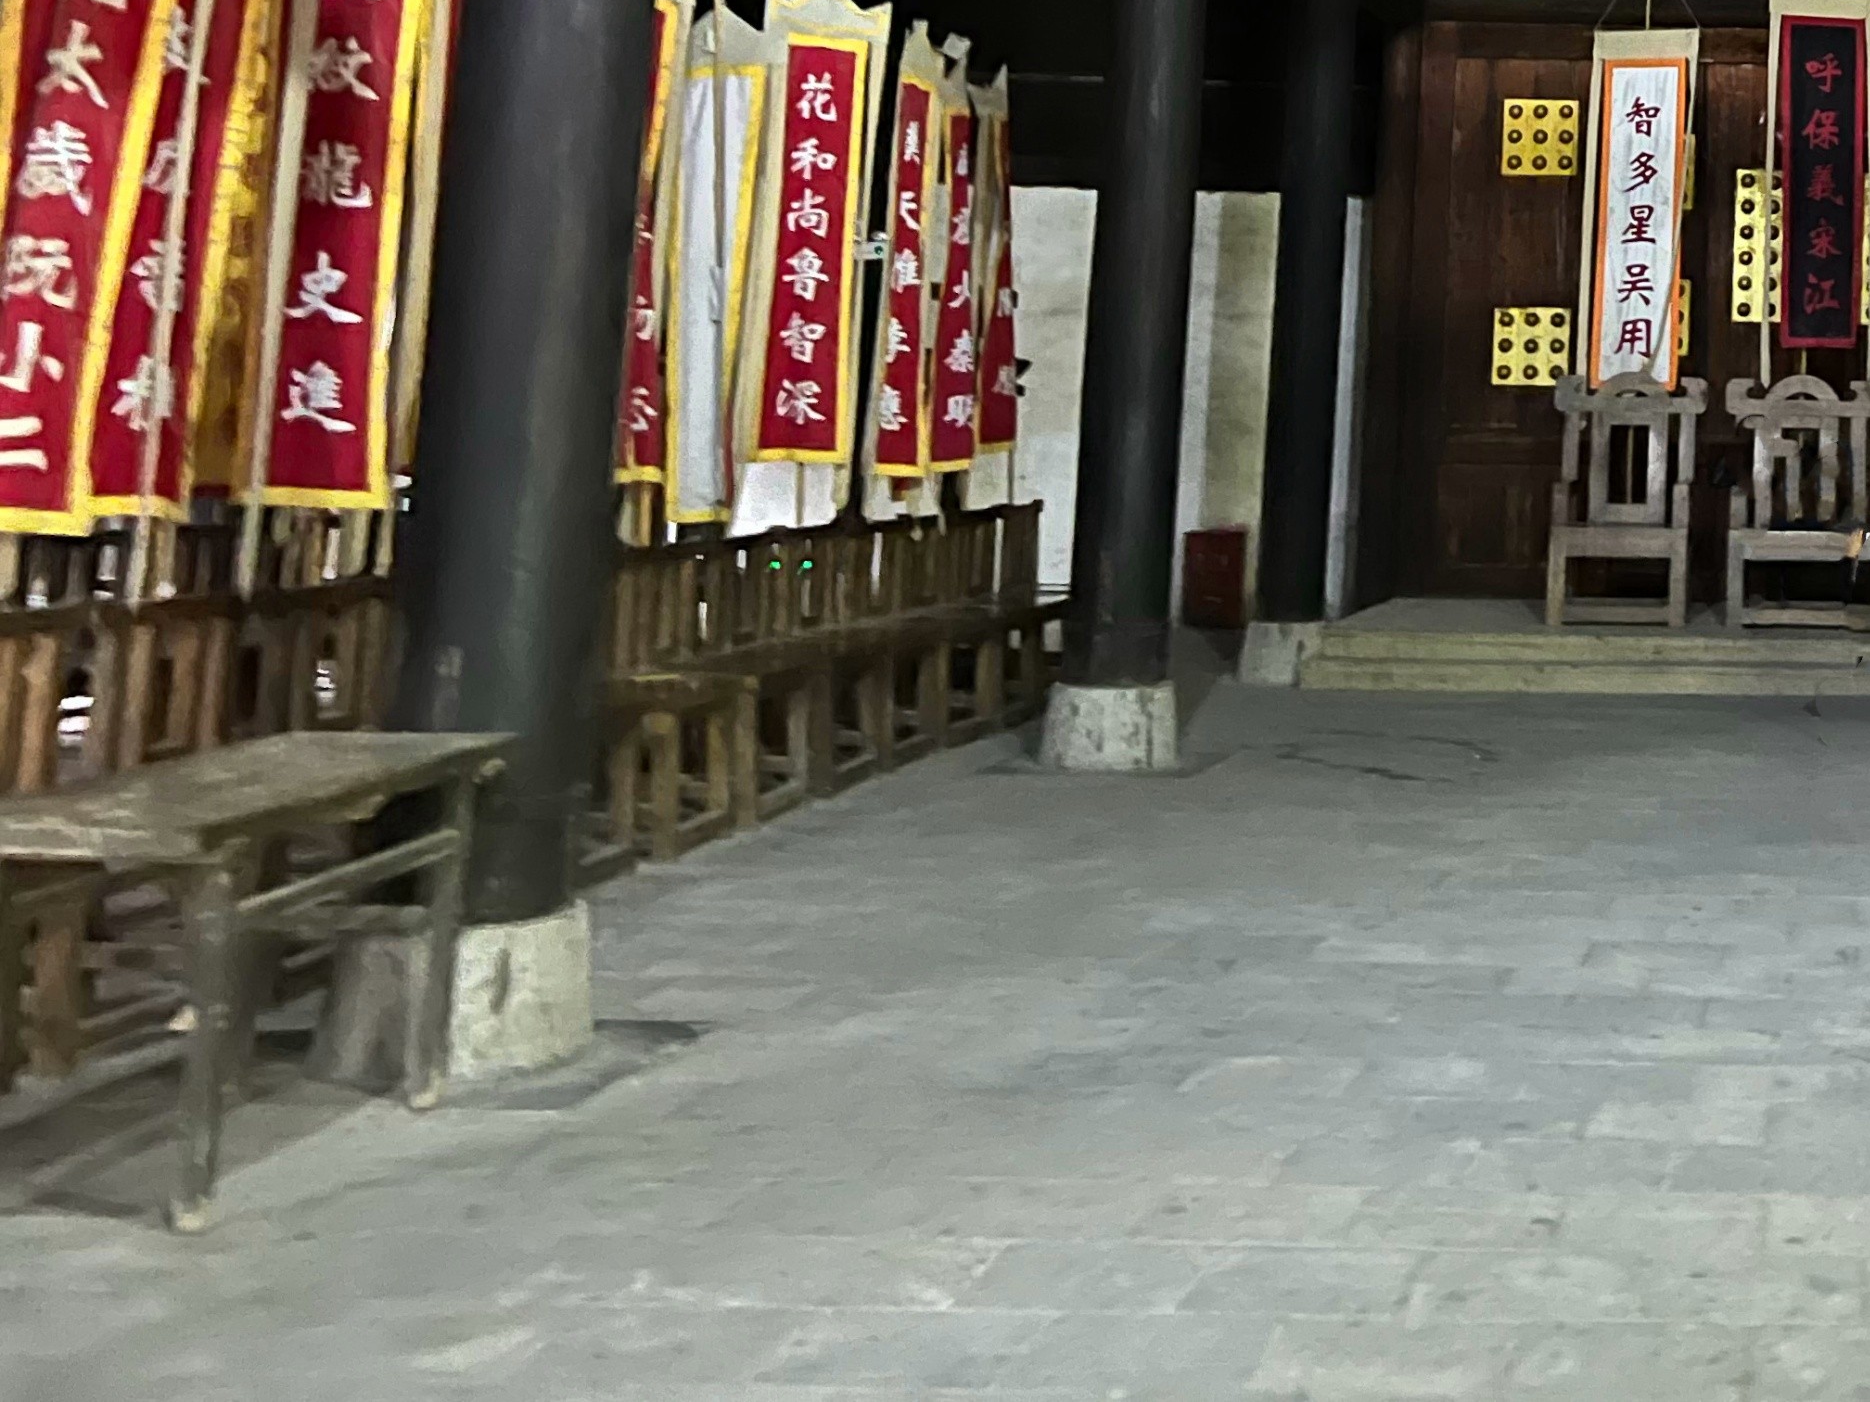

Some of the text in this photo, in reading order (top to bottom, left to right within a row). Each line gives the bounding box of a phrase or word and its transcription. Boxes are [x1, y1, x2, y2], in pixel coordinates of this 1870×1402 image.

[776, 73, 838, 424] 花和尚魯智深
